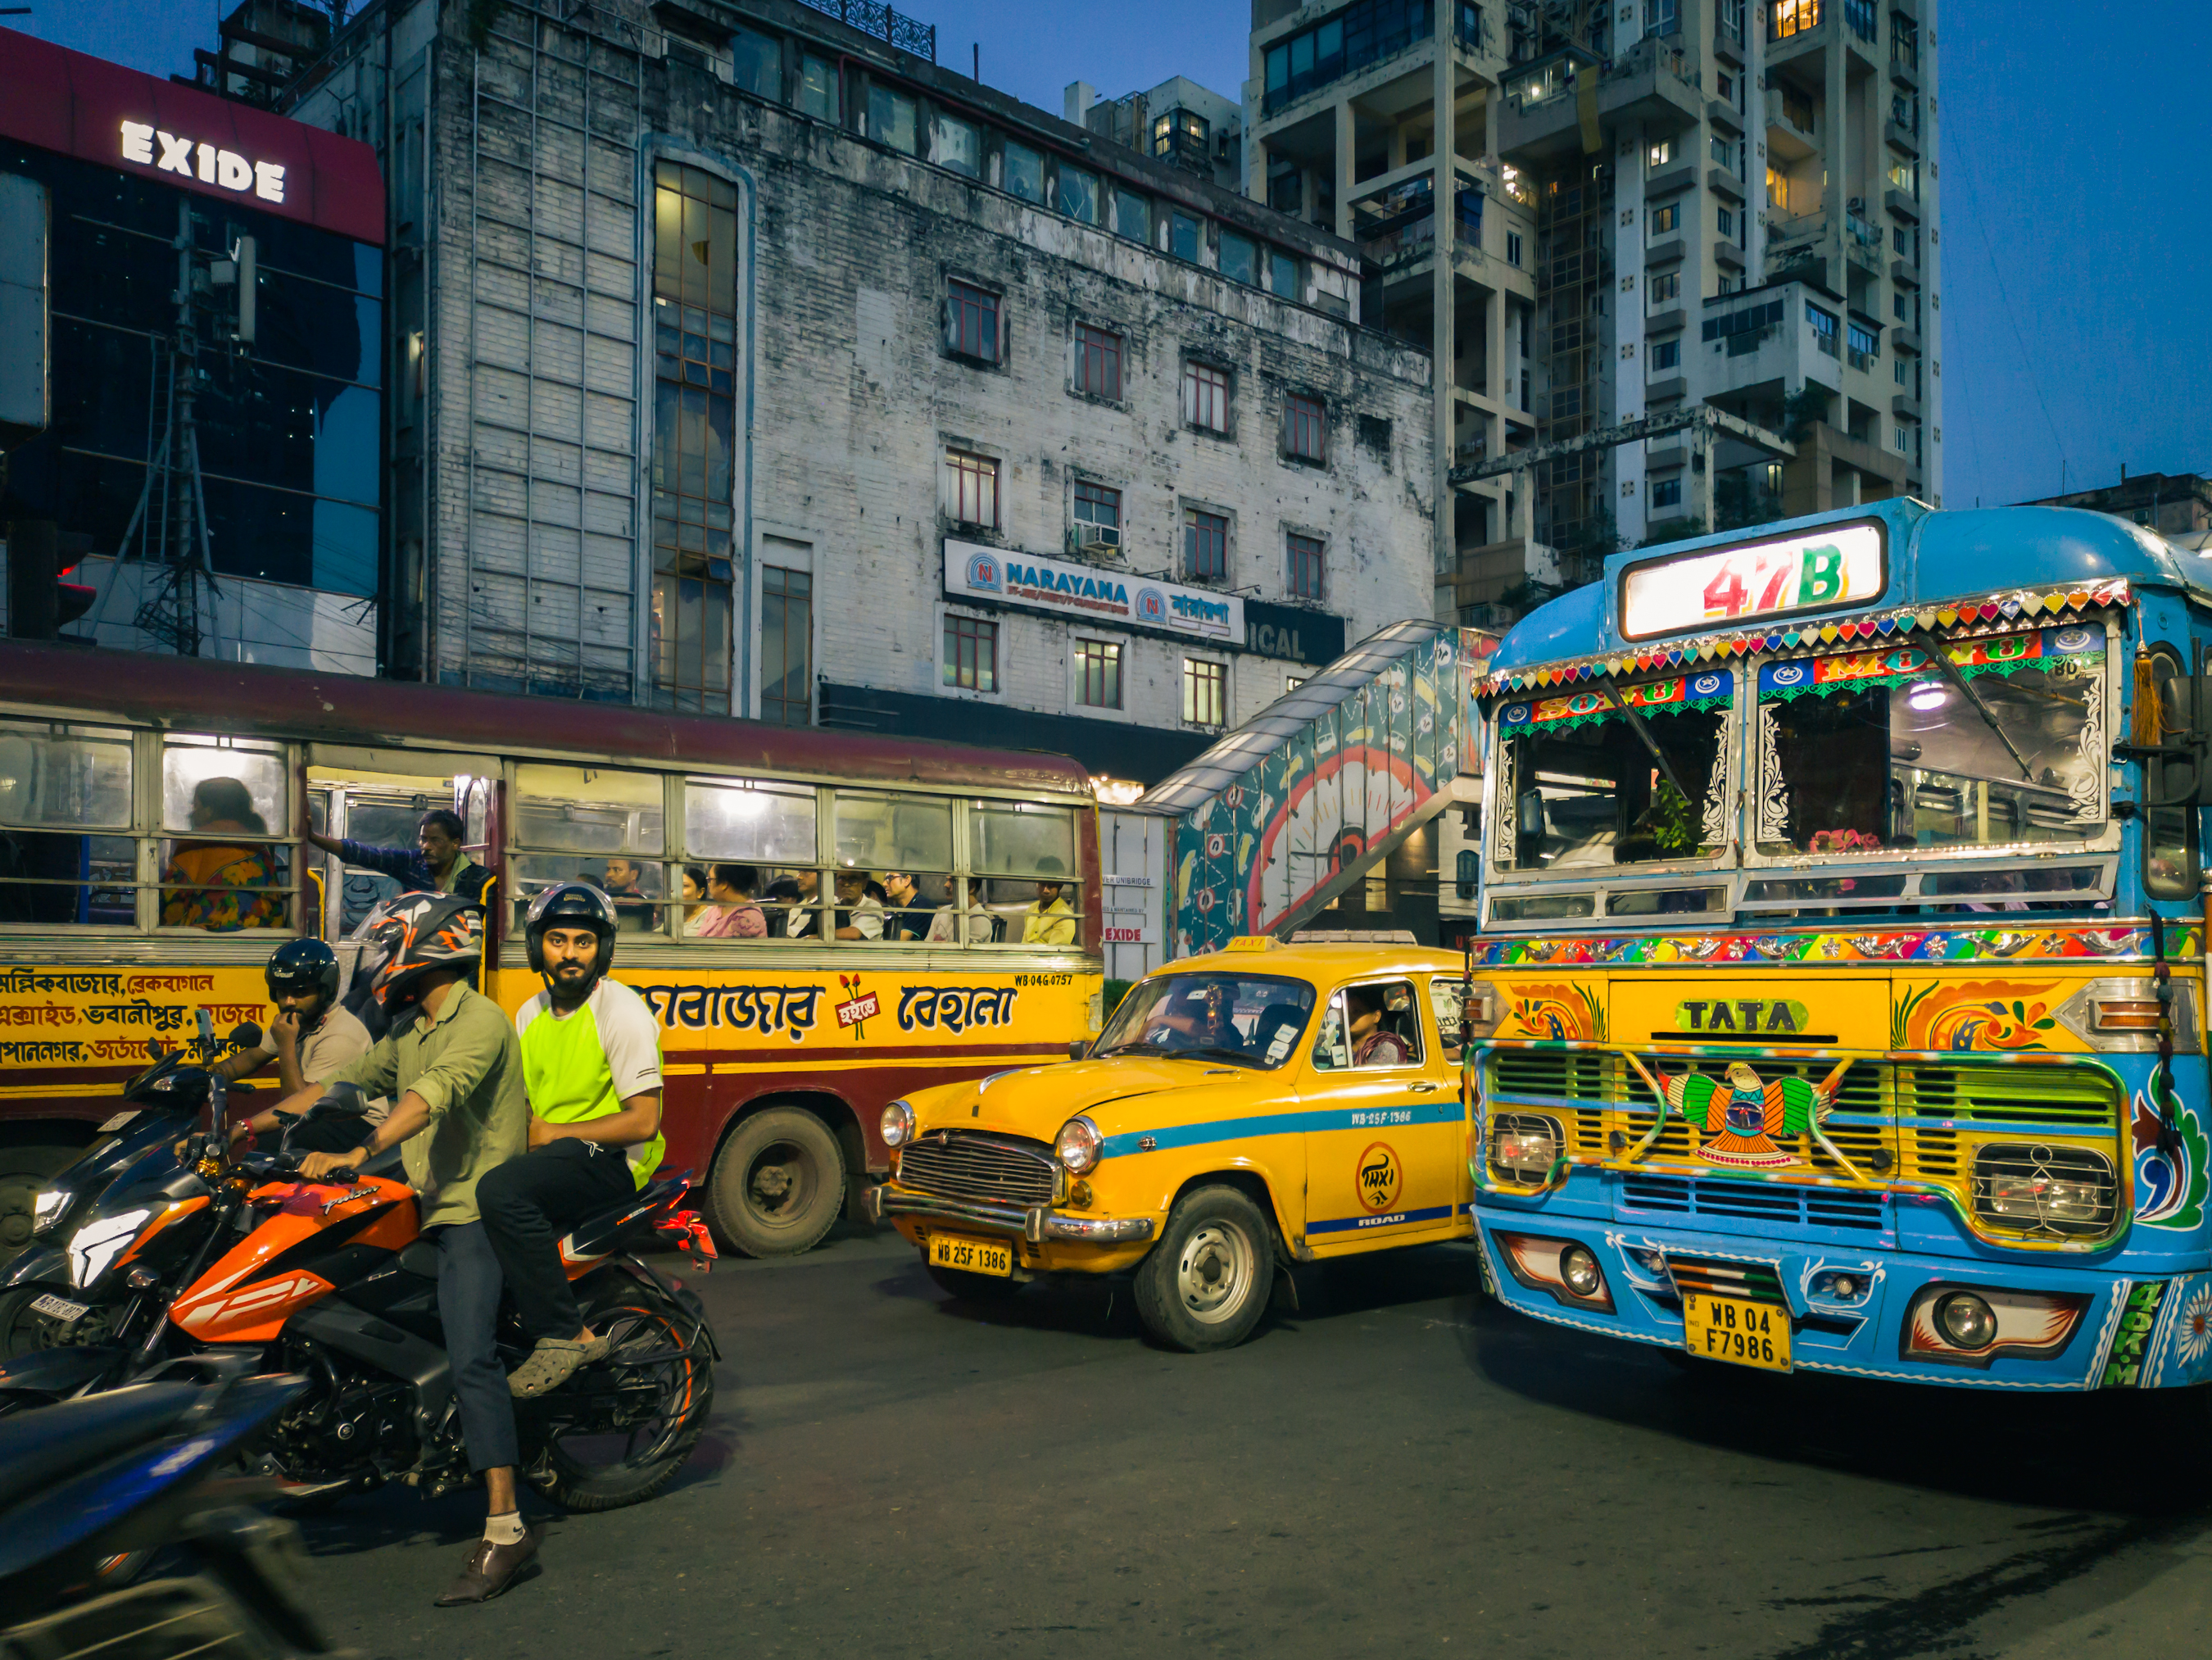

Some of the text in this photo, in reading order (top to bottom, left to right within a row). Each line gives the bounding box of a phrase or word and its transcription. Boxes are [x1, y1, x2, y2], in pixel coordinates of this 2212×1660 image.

[120, 120, 286, 204] EXIDE
[1007, 562, 1129, 605] NARAYANA
[1703, 544, 1843, 618] 47B
[1116, 877, 1151, 885] UNIBRIDGE
[1105, 928, 1141, 941] EXIDE
[1233, 938, 1264, 947] TAXI
[898, 985, 1018, 1036] বেহালা
[1684, 1001, 1797, 1032] TATA
[1358, 1214, 1406, 1227] ROAD
[938, 1244, 1007, 1271] WB 25F 1386
[1688, 1319, 1700, 1327] IND
[1711, 1302, 1770, 1335] WB 04
[1707, 1328, 1774, 1362] F7986
